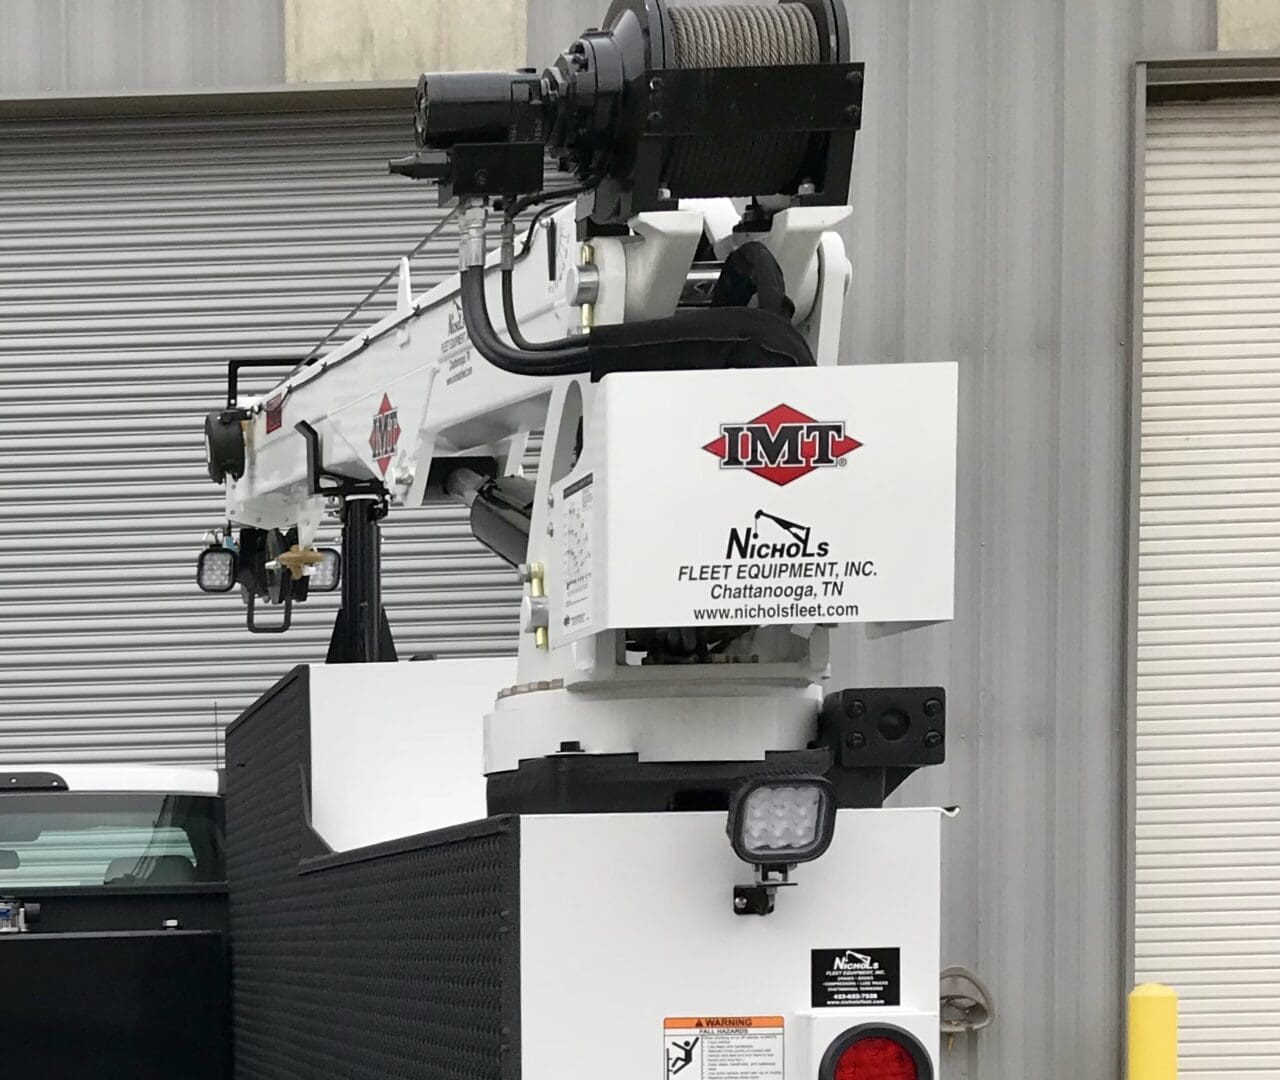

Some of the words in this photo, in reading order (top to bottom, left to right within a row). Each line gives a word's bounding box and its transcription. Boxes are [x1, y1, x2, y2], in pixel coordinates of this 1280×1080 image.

[721, 422, 844, 468] IMT
[678, 564, 731, 581] FLEET
[736, 562, 839, 580] EQUIPMENT,
[844, 561, 877, 578] INC.
[711, 583, 817, 601] Chattanooga,
[822, 581, 844, 597] TN
[694, 603, 859, 620] www.nicholsfleet.com
[706, 1018, 752, 1027] WARNING
